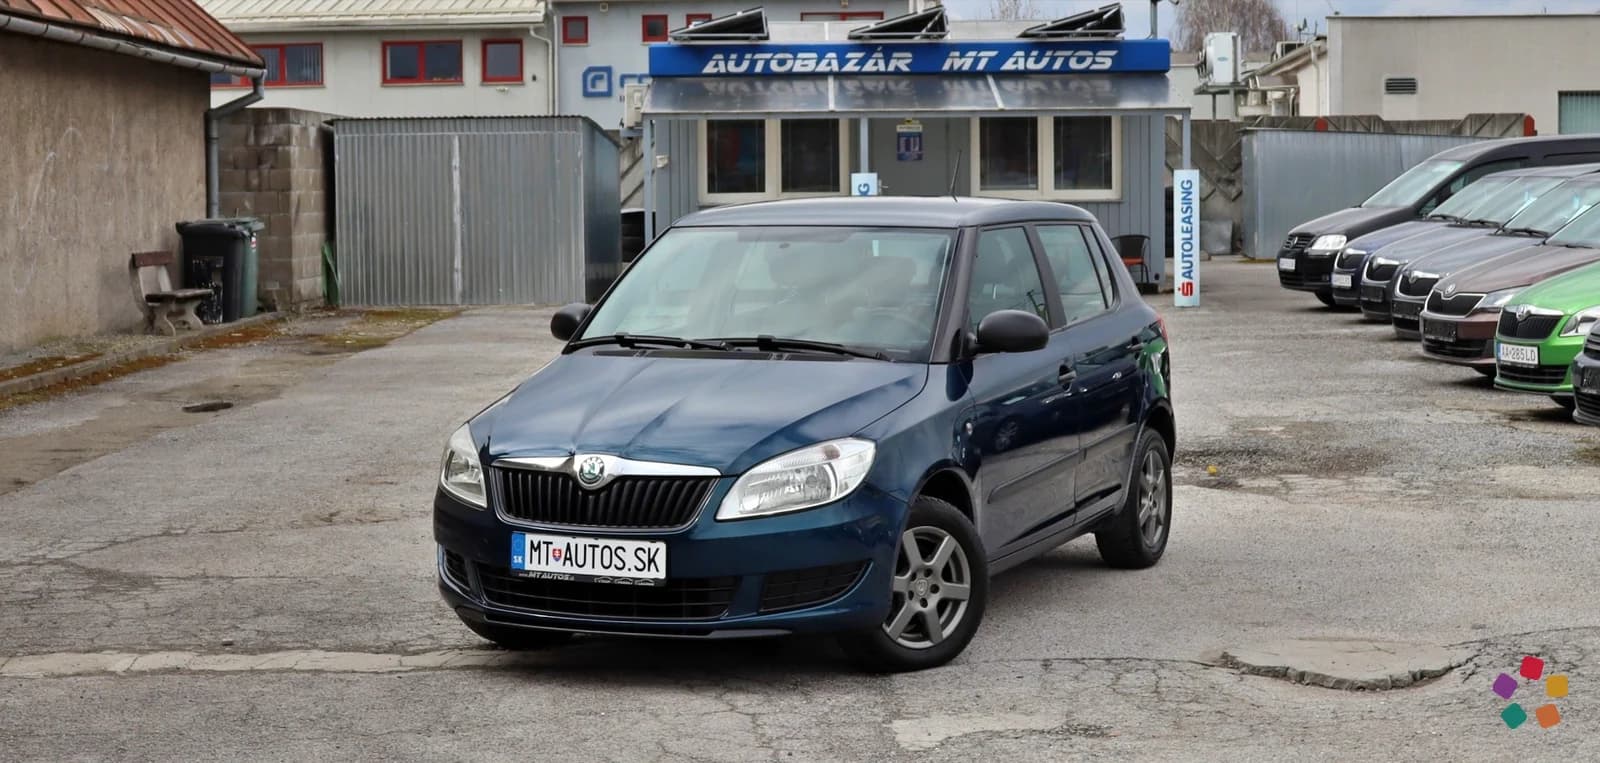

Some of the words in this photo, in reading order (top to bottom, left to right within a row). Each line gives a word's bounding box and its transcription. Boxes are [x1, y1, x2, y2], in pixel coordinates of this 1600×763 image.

[702, 46, 912, 73] AUTOBAZÁR
[942, 50, 999, 71] MT
[1000, 50, 1118, 71] AUTOS
[1181, 179, 1193, 280] AUTOLEASING
